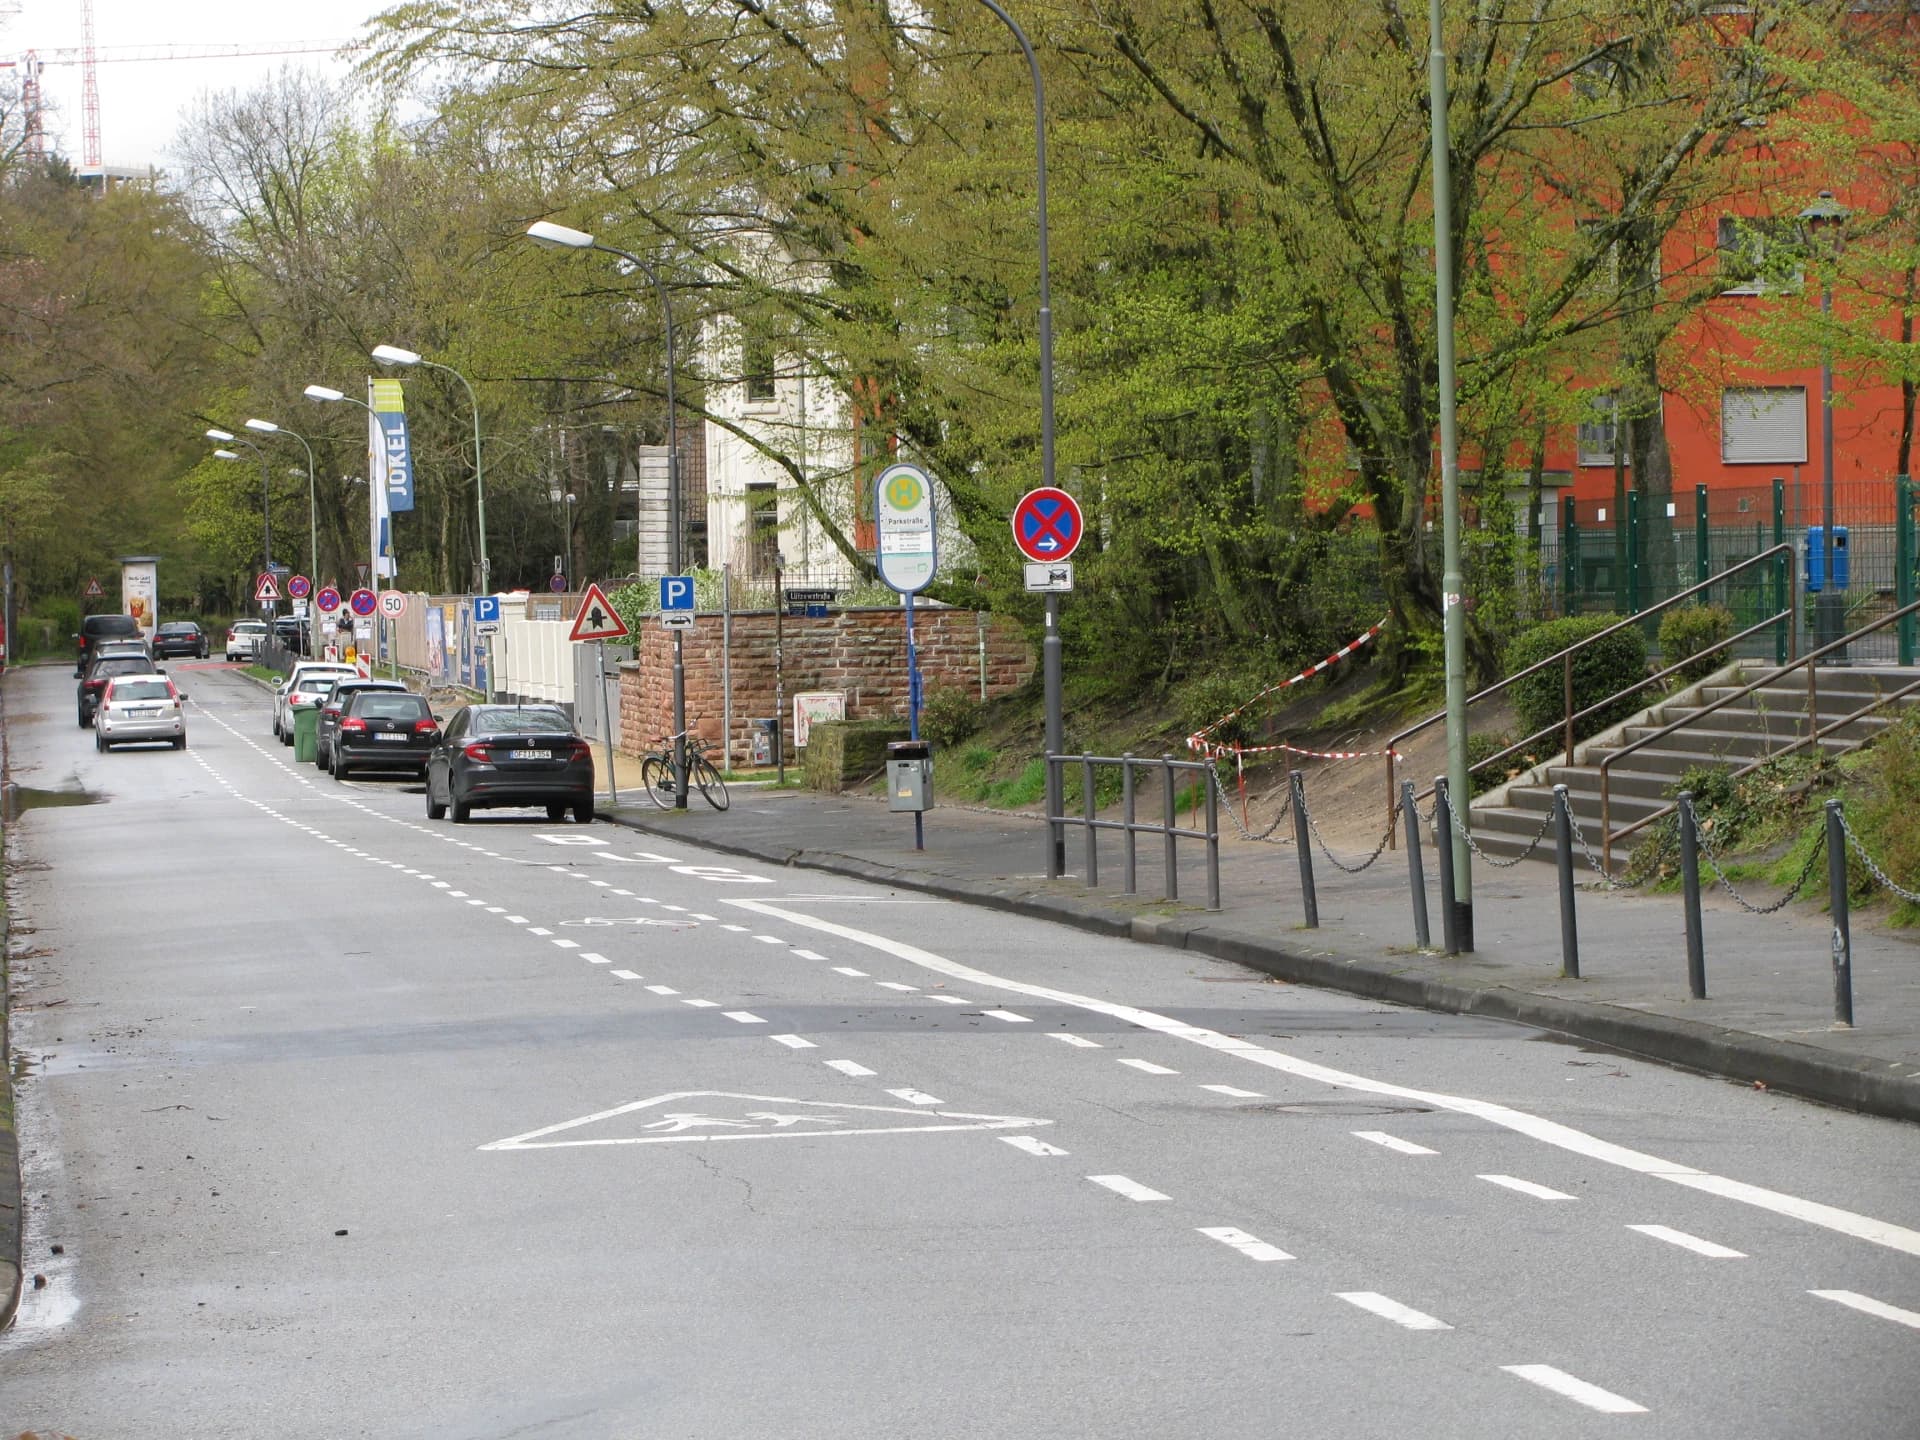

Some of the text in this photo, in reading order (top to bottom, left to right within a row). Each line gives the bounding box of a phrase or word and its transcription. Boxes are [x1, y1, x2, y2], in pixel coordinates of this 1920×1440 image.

[387, 422, 407, 496] JOKEL
[896, 483, 912, 500] H
[888, 517, 924, 525] Parkstraße
[668, 581, 686, 606] P
[385, 598, 402, 611] 50
[480, 600, 494, 619] P
[532, 834, 777, 883] BUS
